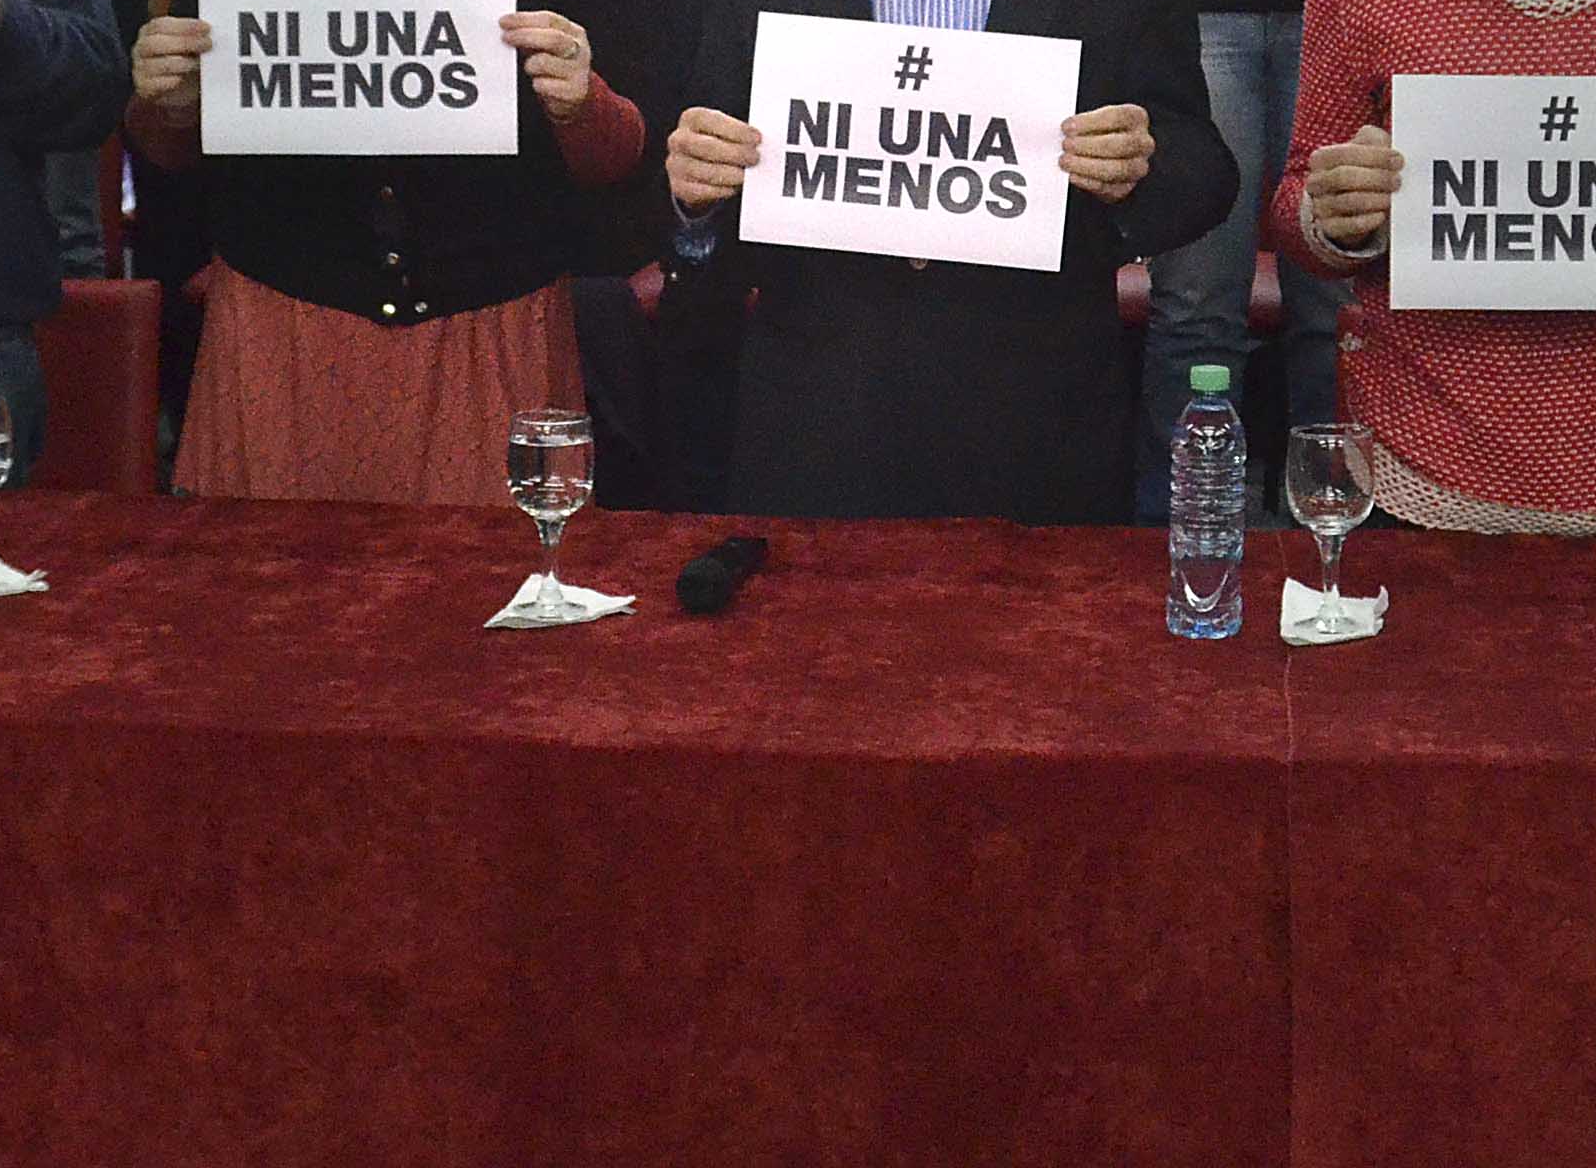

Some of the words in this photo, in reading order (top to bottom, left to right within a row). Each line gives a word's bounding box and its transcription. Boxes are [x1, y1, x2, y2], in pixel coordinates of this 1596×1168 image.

[237, 11, 300, 58] NI
[327, 10, 465, 58] UNA
[239, 60, 480, 110] MENOS
[894, 46, 933, 92] #
[787, 99, 851, 151] NI
[876, 107, 1019, 167] UNA
[1539, 95, 1580, 142] #
[781, 151, 1029, 220] MENOS
[1430, 158, 1499, 208] NI
